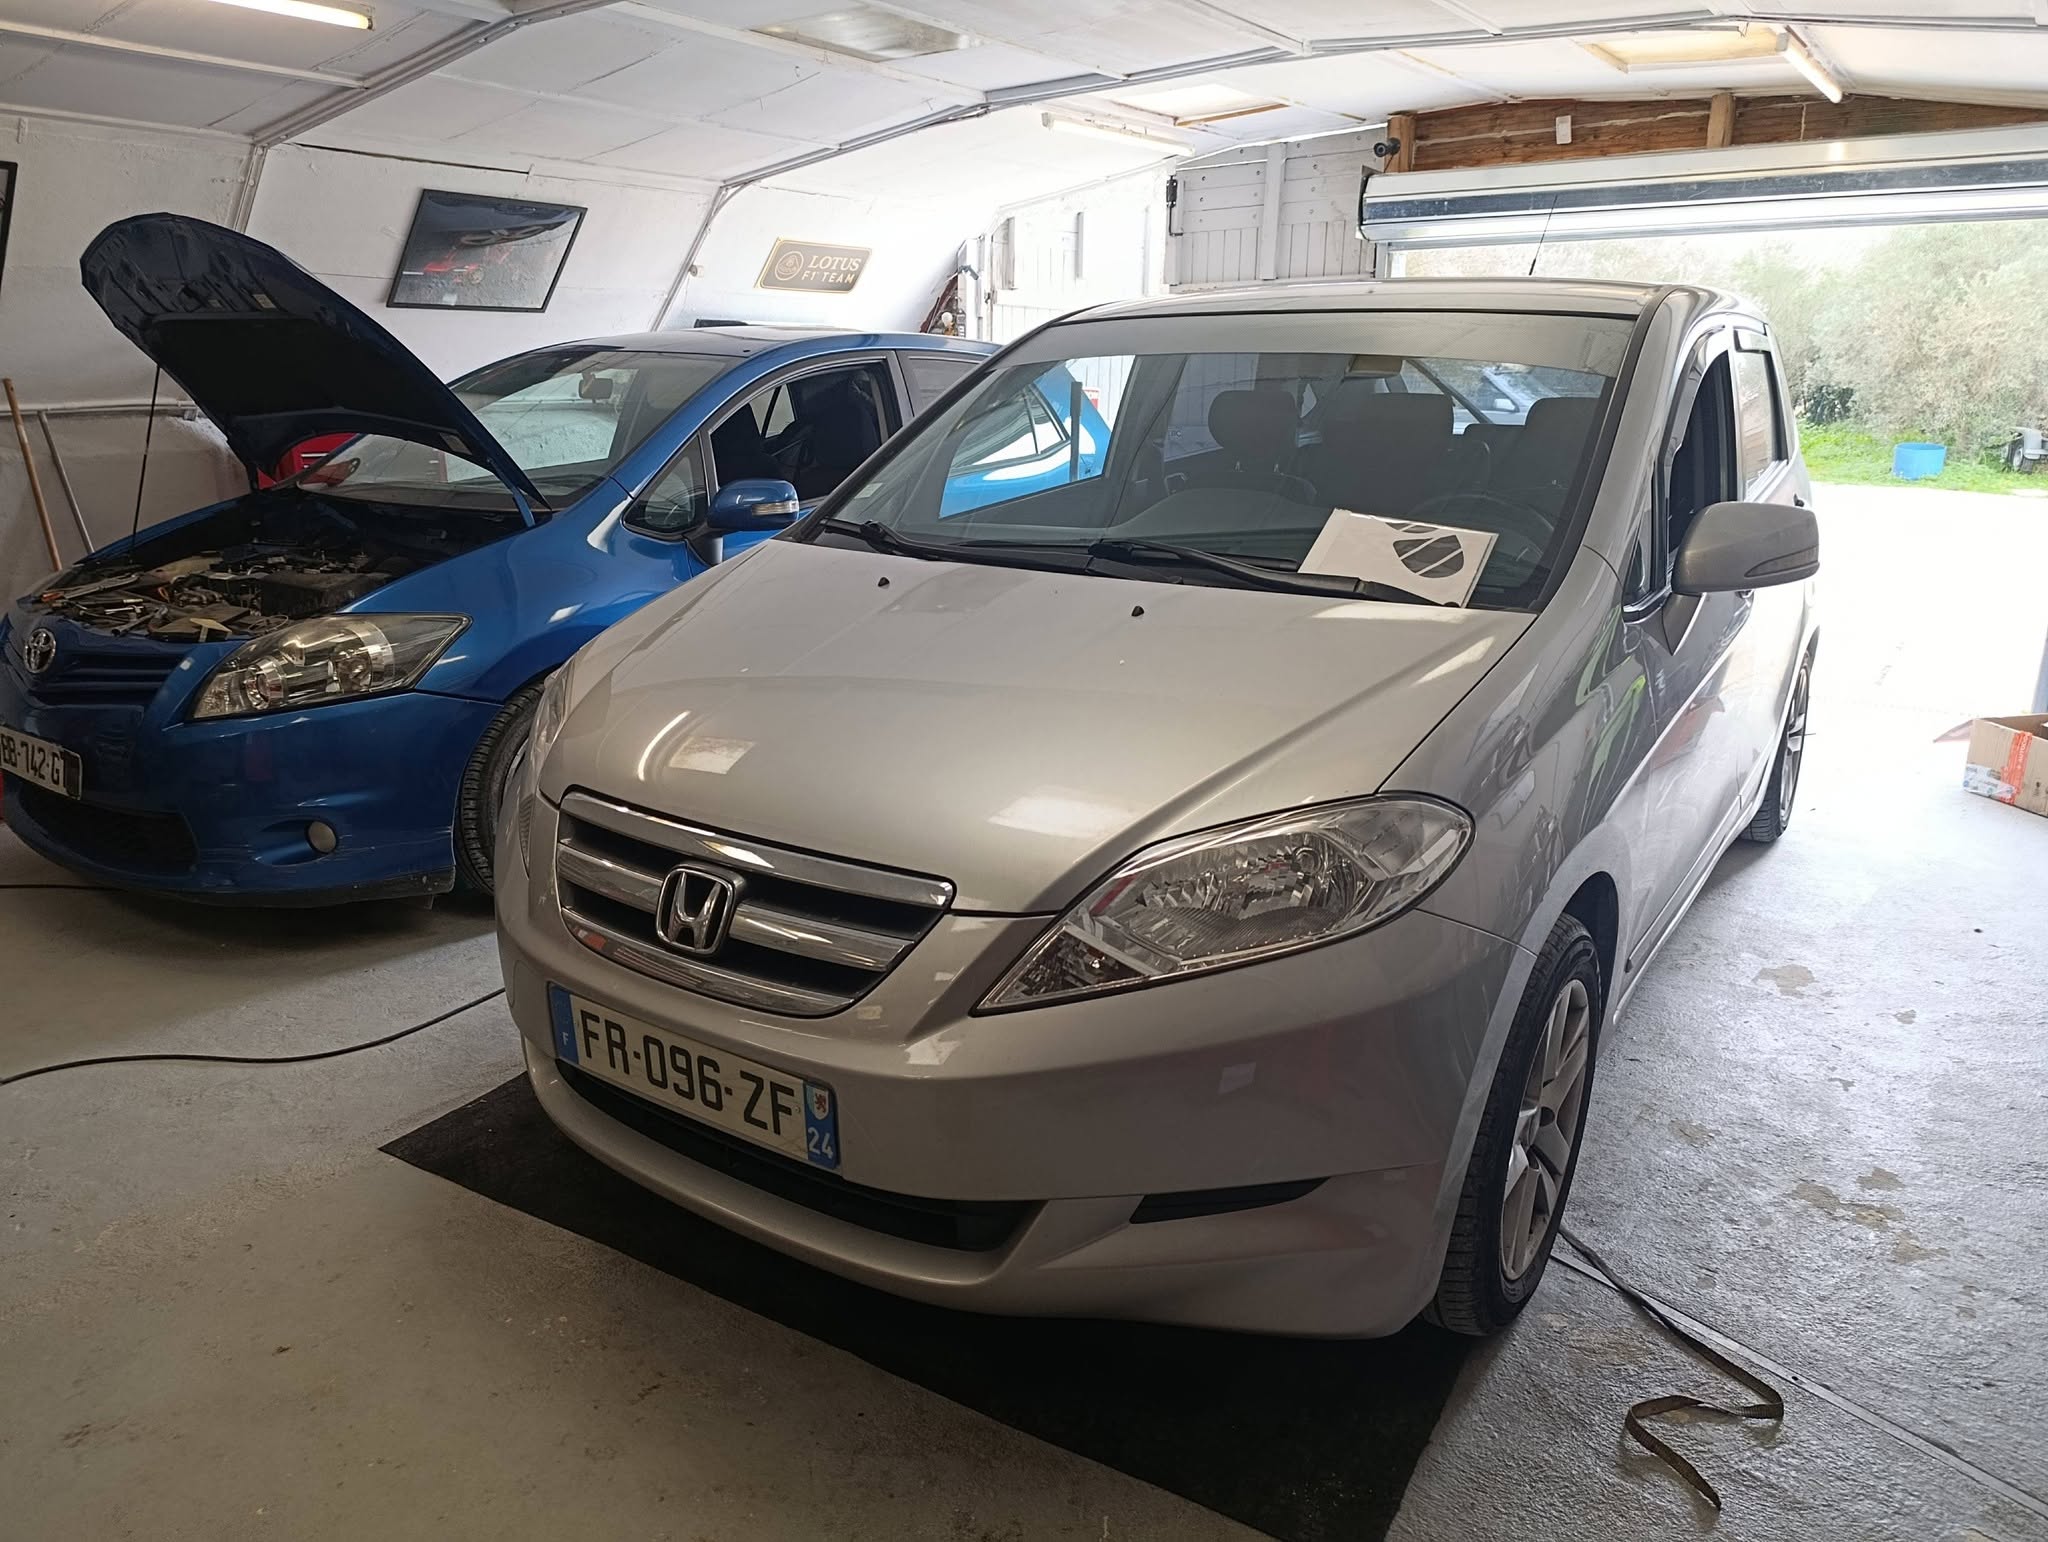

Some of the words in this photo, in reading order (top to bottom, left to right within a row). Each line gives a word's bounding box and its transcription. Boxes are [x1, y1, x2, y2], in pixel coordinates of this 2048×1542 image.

[808, 255, 862, 272] LOTUS
[821, 271, 855, 284] TEAM
[561, 1032, 570, 1046] F
[580, 1009, 795, 1136] FR-096-ZF
[807, 1127, 834, 1160] 24
